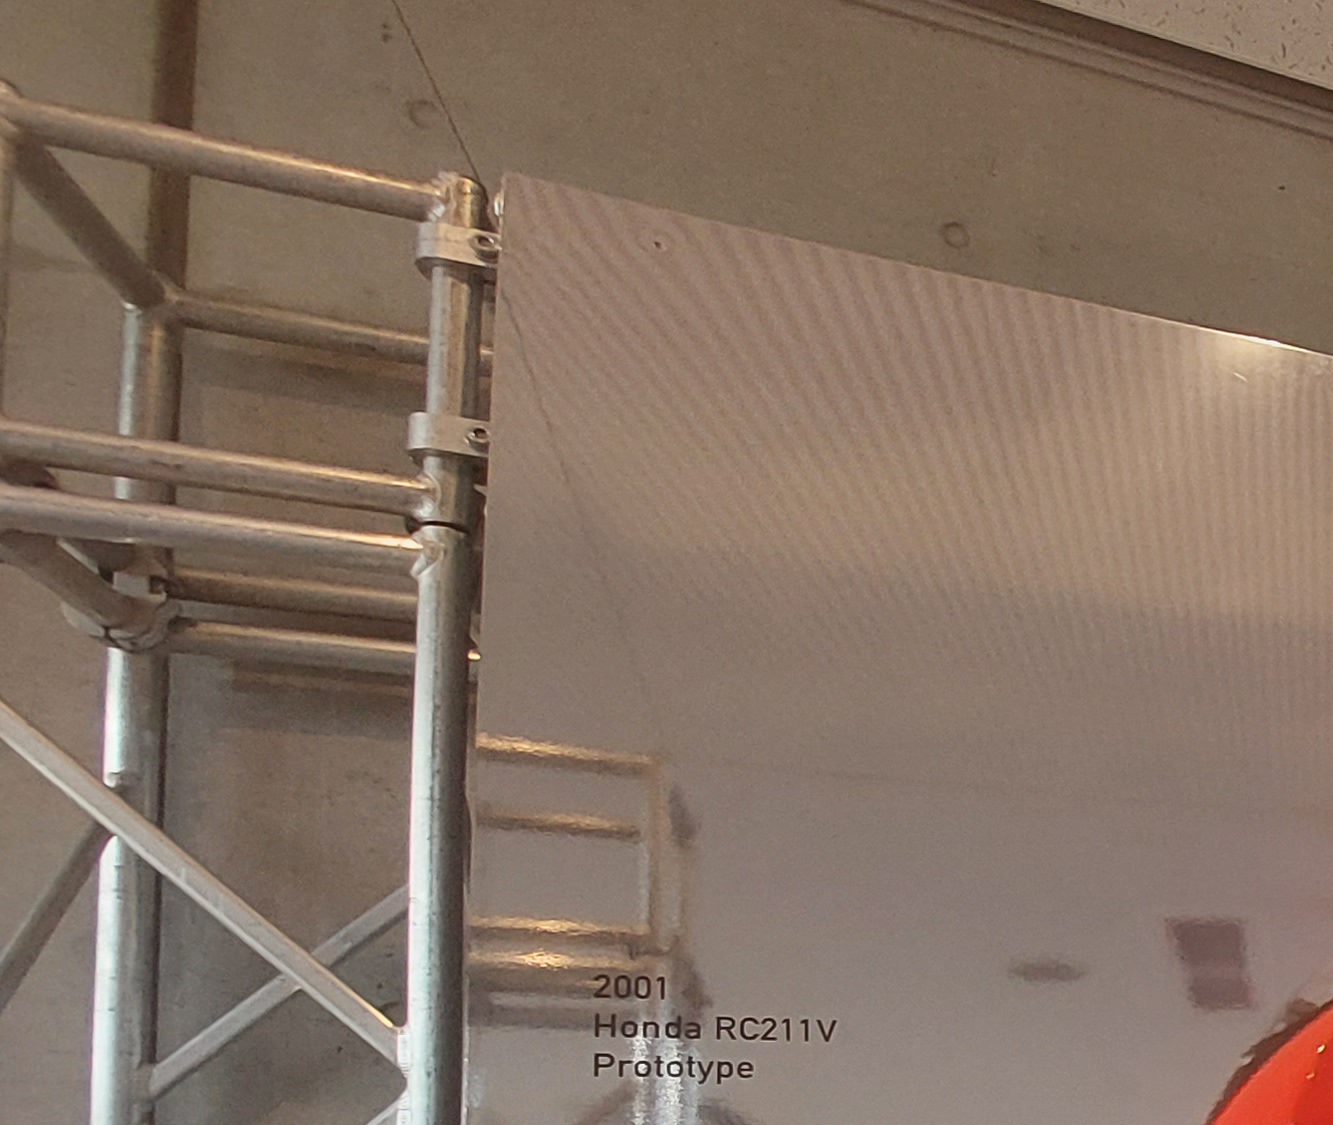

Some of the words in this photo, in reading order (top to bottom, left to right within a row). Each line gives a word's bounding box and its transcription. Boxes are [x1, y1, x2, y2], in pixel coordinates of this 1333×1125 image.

[592, 974, 667, 1000] 2001
[593, 1013, 702, 1040] Honda
[715, 1016, 838, 1043] RC211V
[593, 1053, 755, 1085] Prototype
